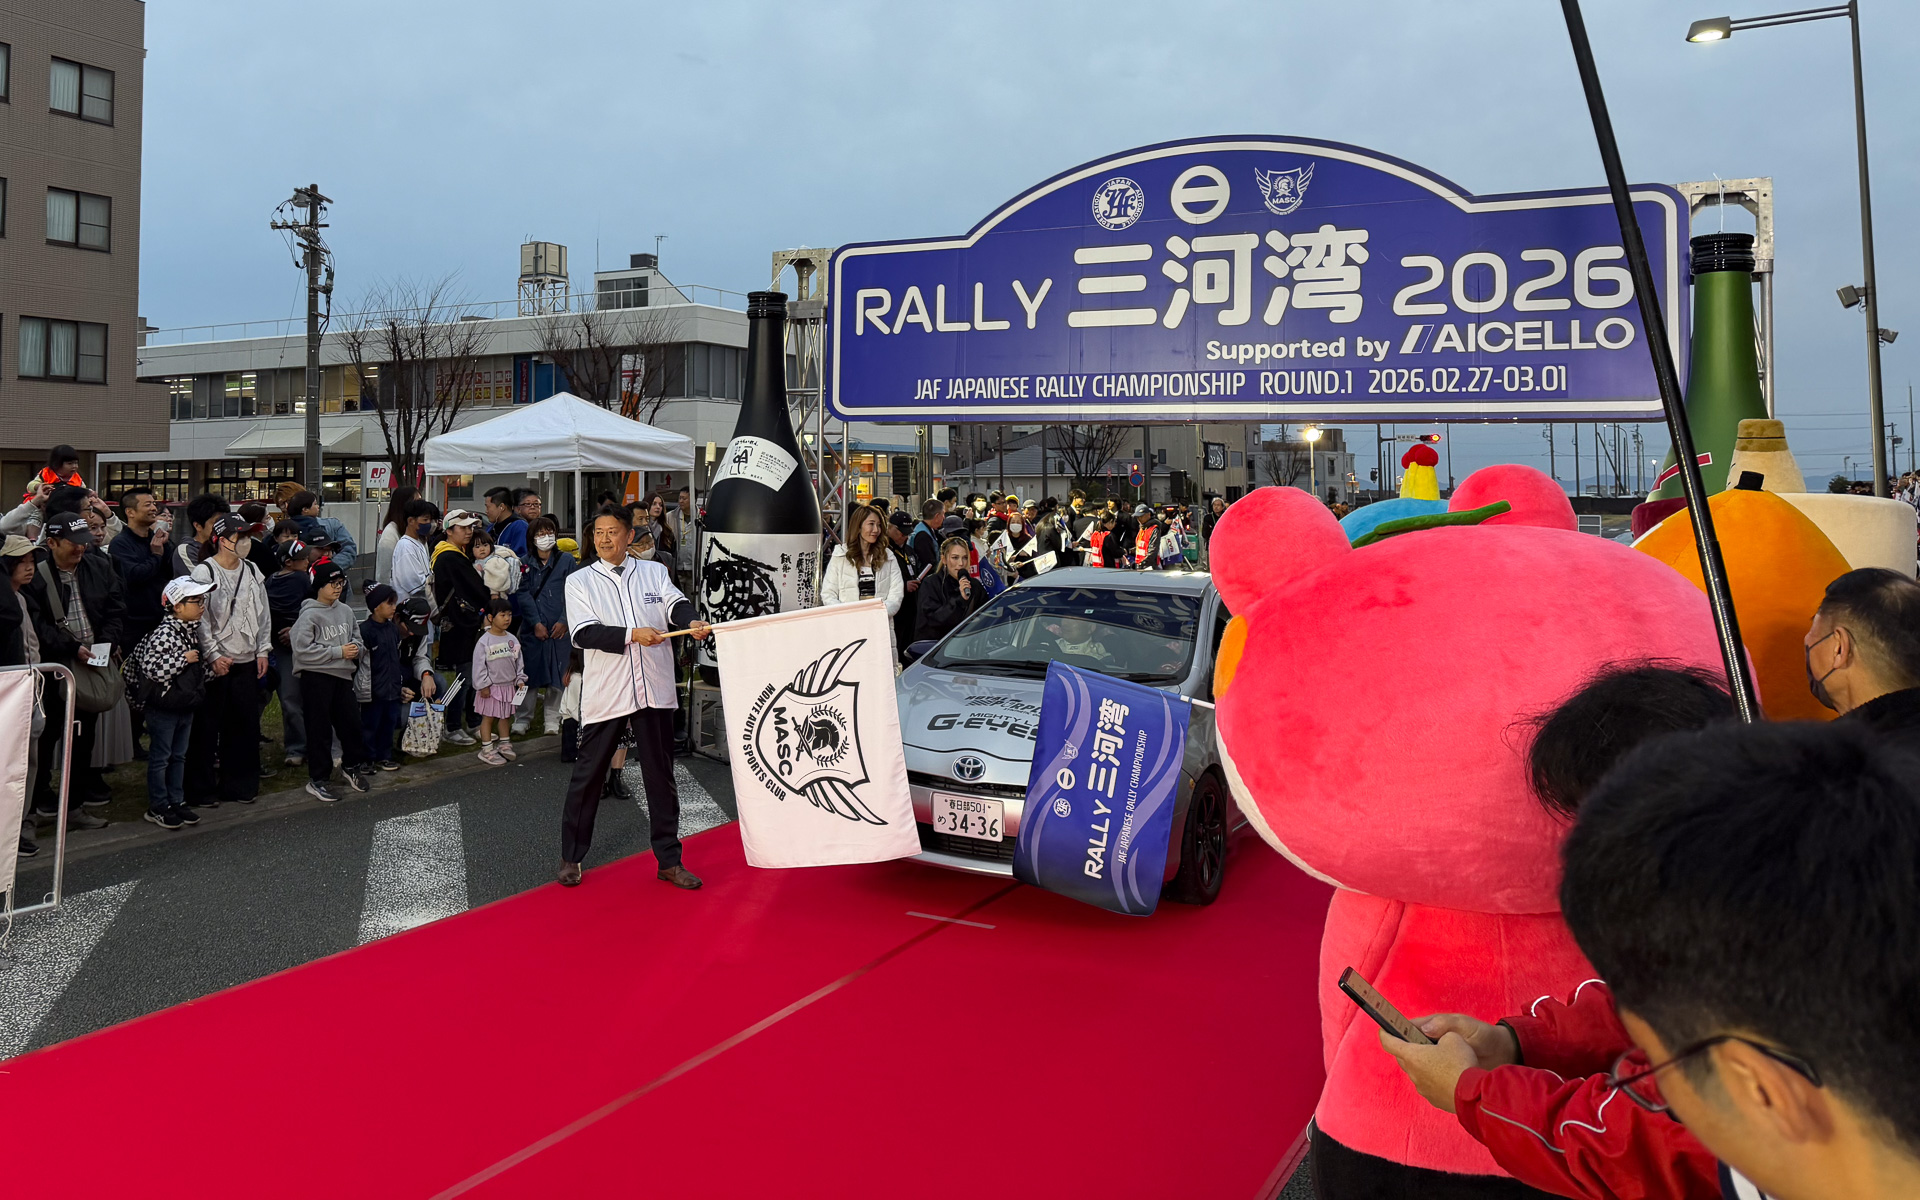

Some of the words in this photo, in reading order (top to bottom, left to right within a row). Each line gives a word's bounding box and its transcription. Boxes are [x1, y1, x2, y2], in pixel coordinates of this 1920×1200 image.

[1106, 179, 1132, 189] JAPAN
[1272, 196, 1296, 205] MASC
[856, 278, 1053, 336] RALLY
[1067, 224, 1370, 330] 三河湾
[1392, 245, 1635, 316] 2026
[1206, 337, 1345, 364] Supported
[1356, 336, 1391, 362] by
[1432, 317, 1635, 353] AICELLO
[914, 378, 942, 400] JAF
[946, 376, 1029, 400] JAPANESE
[1035, 375, 1087, 398] RALLY
[1092, 372, 1246, 397] CHAMPIONSHIP
[1260, 370, 1353, 395] ROUND.1
[1368, 365, 1567, 394] 2026.02.27-03.01
[751, 683, 776, 715] MONTE
[989, 699, 1042, 714] PURPL
[742, 713, 757, 741] AUTO
[970, 713, 1021, 722] MIGHTY
[772, 706, 793, 777] MASC
[1087, 697, 1130, 799] 三河湾
[743, 744, 767, 782] SPORTS
[1129, 729, 1148, 789] CHAMPIONSHIP
[765, 779, 786, 801] CLUB
[1125, 788, 1138, 812] RALLY
[937, 815, 947, 826] め
[948, 811, 999, 838] 34-36
[1084, 799, 1112, 879] RALLY
[1119, 809, 1134, 850] JAPANESE
[1118, 848, 1127, 864] JAF
